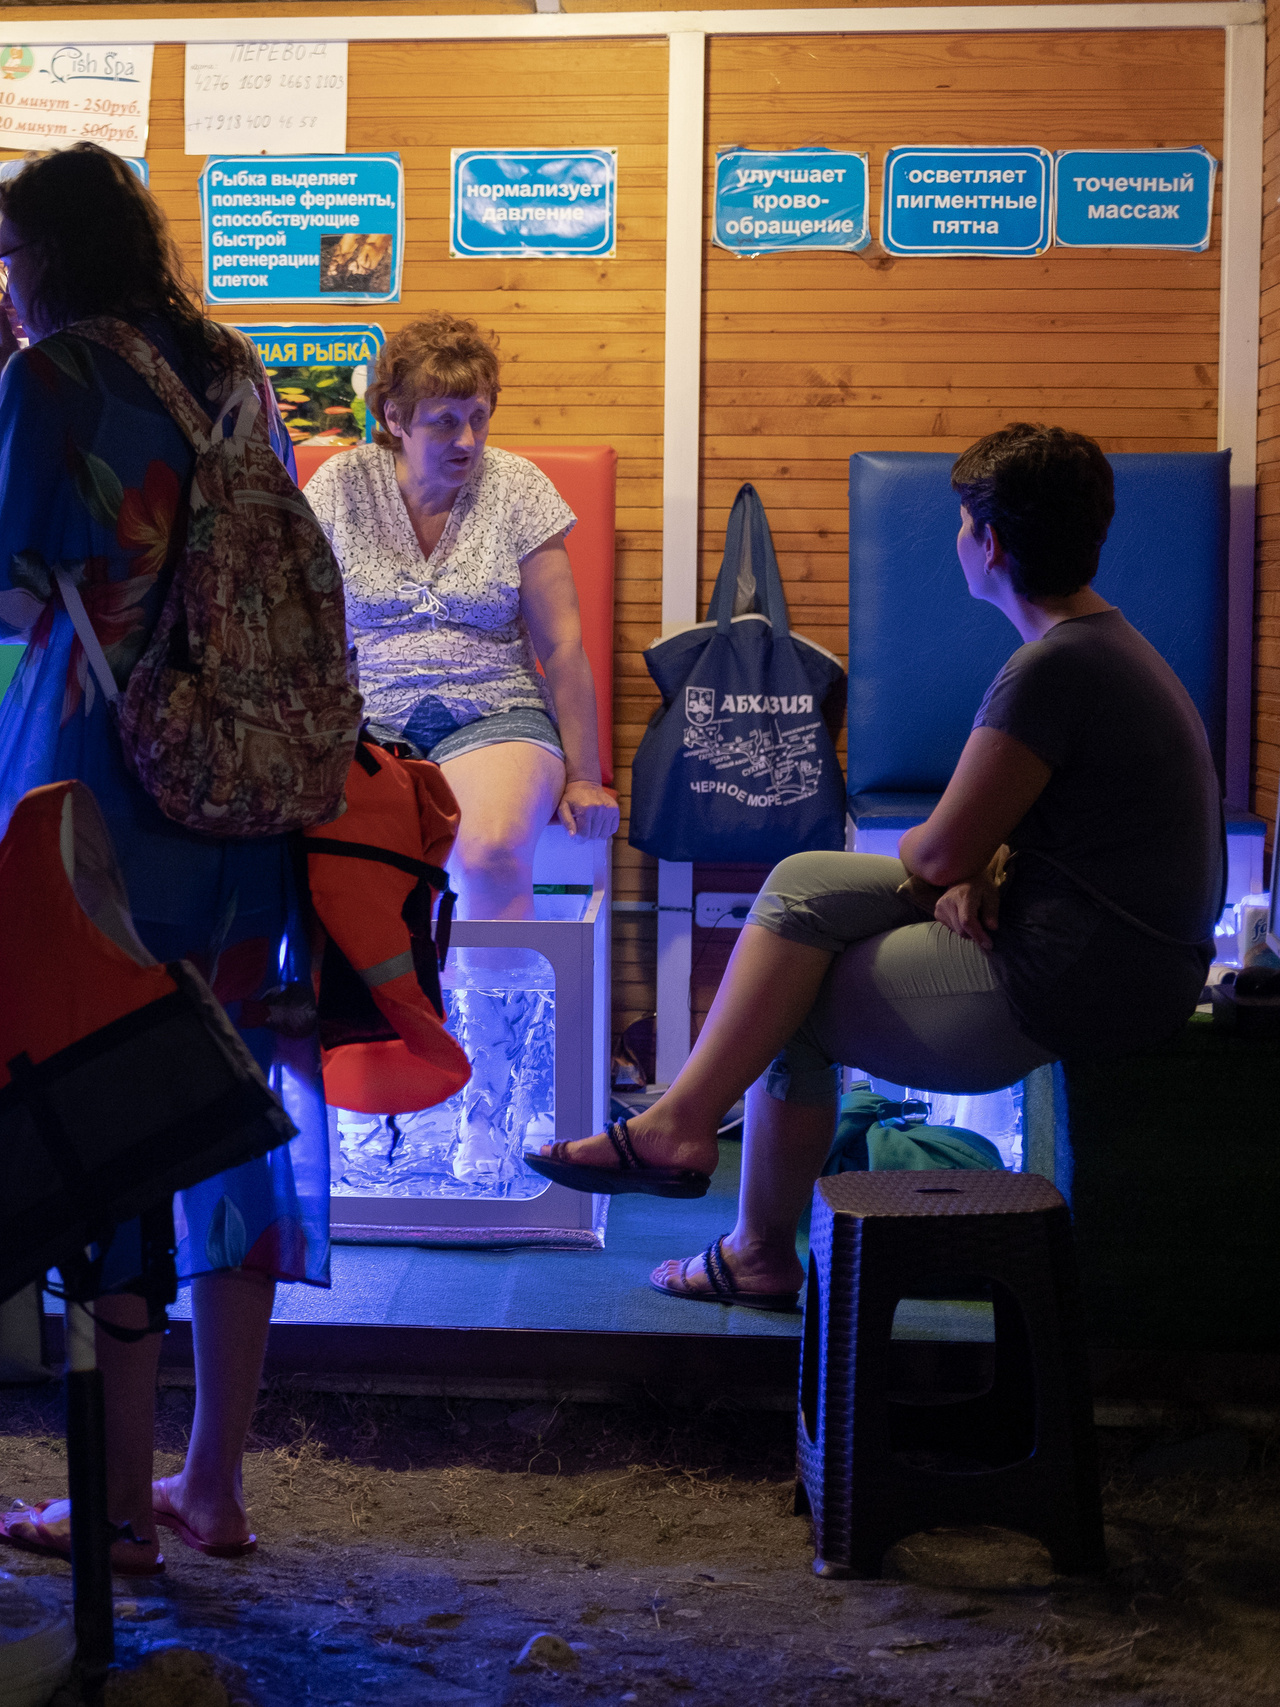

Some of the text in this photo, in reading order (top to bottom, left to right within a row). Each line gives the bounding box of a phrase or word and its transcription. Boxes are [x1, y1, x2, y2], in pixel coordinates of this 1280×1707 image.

[229, 43, 328, 63] ПЕРЕВОД
[103, 52, 136, 79] Spa
[194, 74, 230, 91] 4276
[239, 74, 272, 89] 1609
[17, 96, 70, 112] минут
[83, 98, 141, 117] 250руб.
[14, 121, 67, 137] минут
[81, 123, 139, 141] 500руб.
[211, 170, 358, 189] Рыбка выделяет
[736, 168, 847, 189] улучшает
[908, 169, 1027, 184] осветляет
[1072, 172, 1195, 192] точечный
[211, 190, 396, 210] полезные ферменты,
[466, 182, 602, 202] нормализует
[896, 194, 1038, 209] пигментные
[752, 194, 830, 213] крово-
[1087, 203, 1181, 220] массаж
[212, 210, 360, 231] способствующие
[482, 206, 585, 223] давление
[725, 215, 854, 239] обращение
[932, 219, 999, 234] пятна
[212, 230, 287, 250] быстрой
[212, 253, 320, 270] регенерации
[212, 274, 269, 287] клеток
[258, 342, 372, 362] НАЯ РЫБКА
[720, 693, 814, 715] АБХАЗИЯ
[690, 780, 748, 803] ЧЕРНОЕ
[746, 793, 783, 808] МОРЕ
